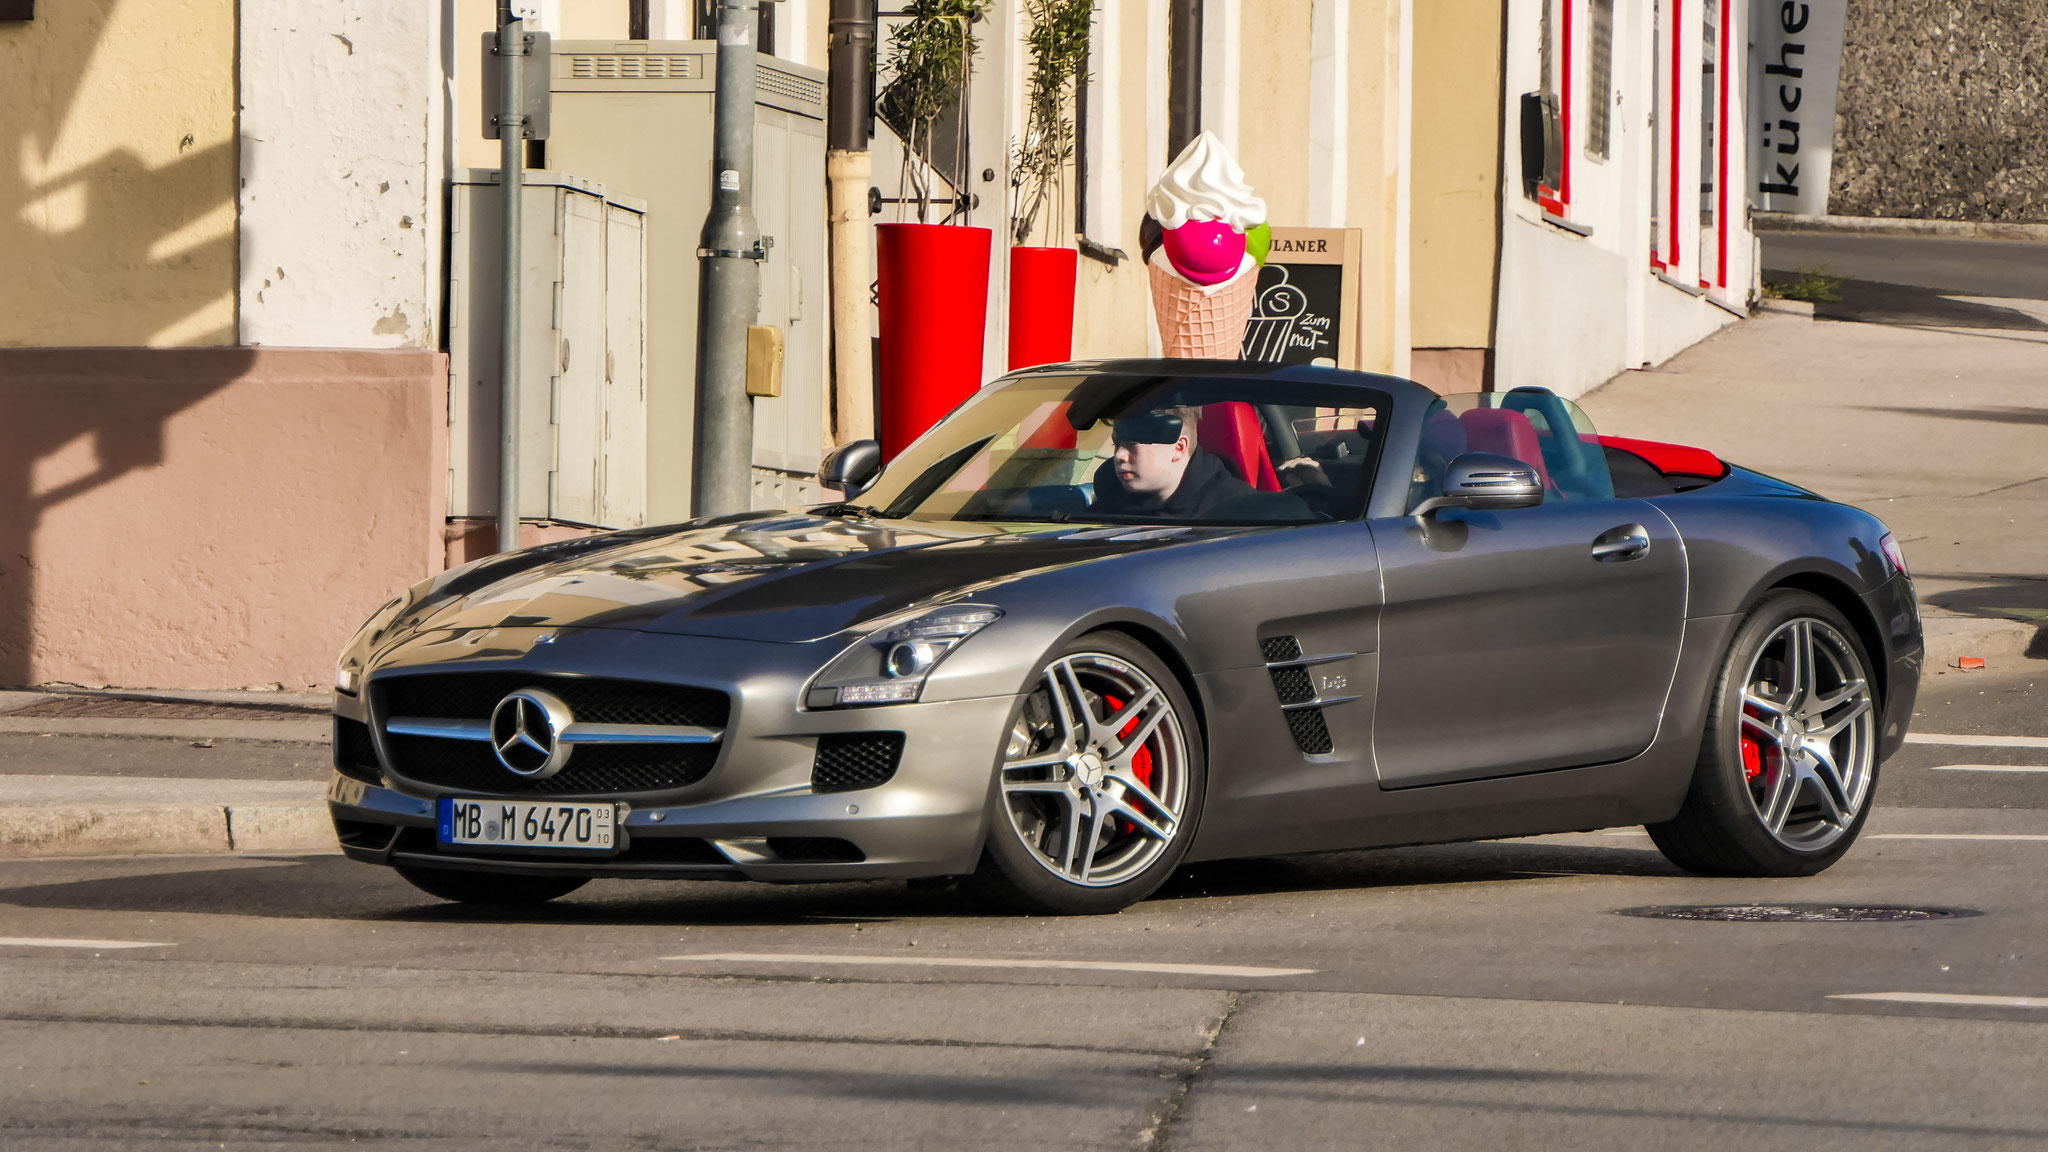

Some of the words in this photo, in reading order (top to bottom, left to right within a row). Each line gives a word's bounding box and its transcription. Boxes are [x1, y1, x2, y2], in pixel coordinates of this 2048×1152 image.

[1299, 313, 1331, 330] Zum
[596, 808, 610, 819] 03
[453, 803, 482, 839] MB
[501, 804, 516, 841] M
[524, 806, 593, 843] 6470
[597, 833, 610, 844] 10
